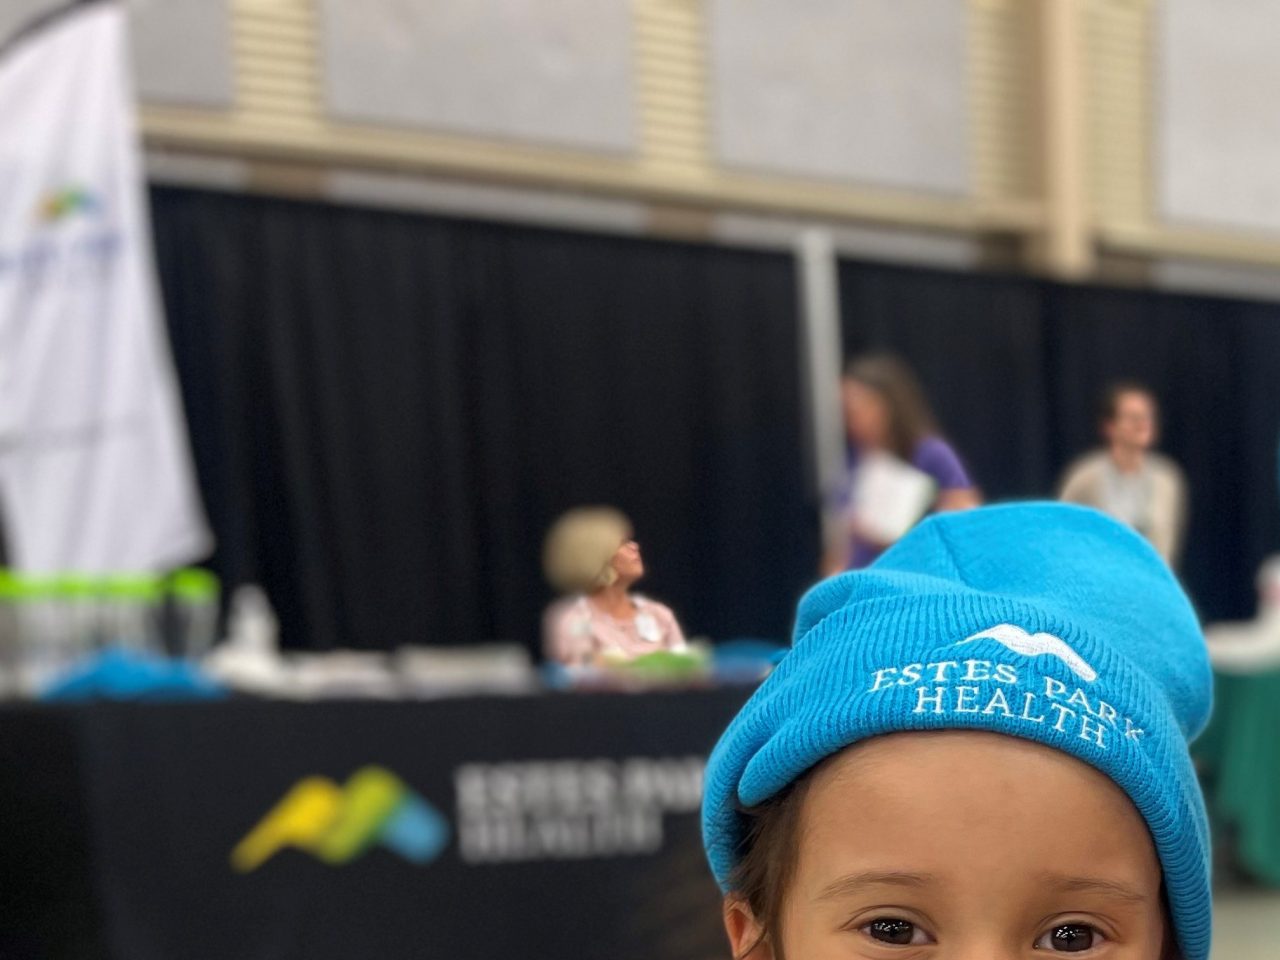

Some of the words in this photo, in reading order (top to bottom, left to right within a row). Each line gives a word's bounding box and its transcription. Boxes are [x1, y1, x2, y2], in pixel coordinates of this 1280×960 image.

[866, 659, 1017, 693] ESTES
[1044, 676, 1145, 742] PARK
[912, 686, 1107, 749] HEALTH
